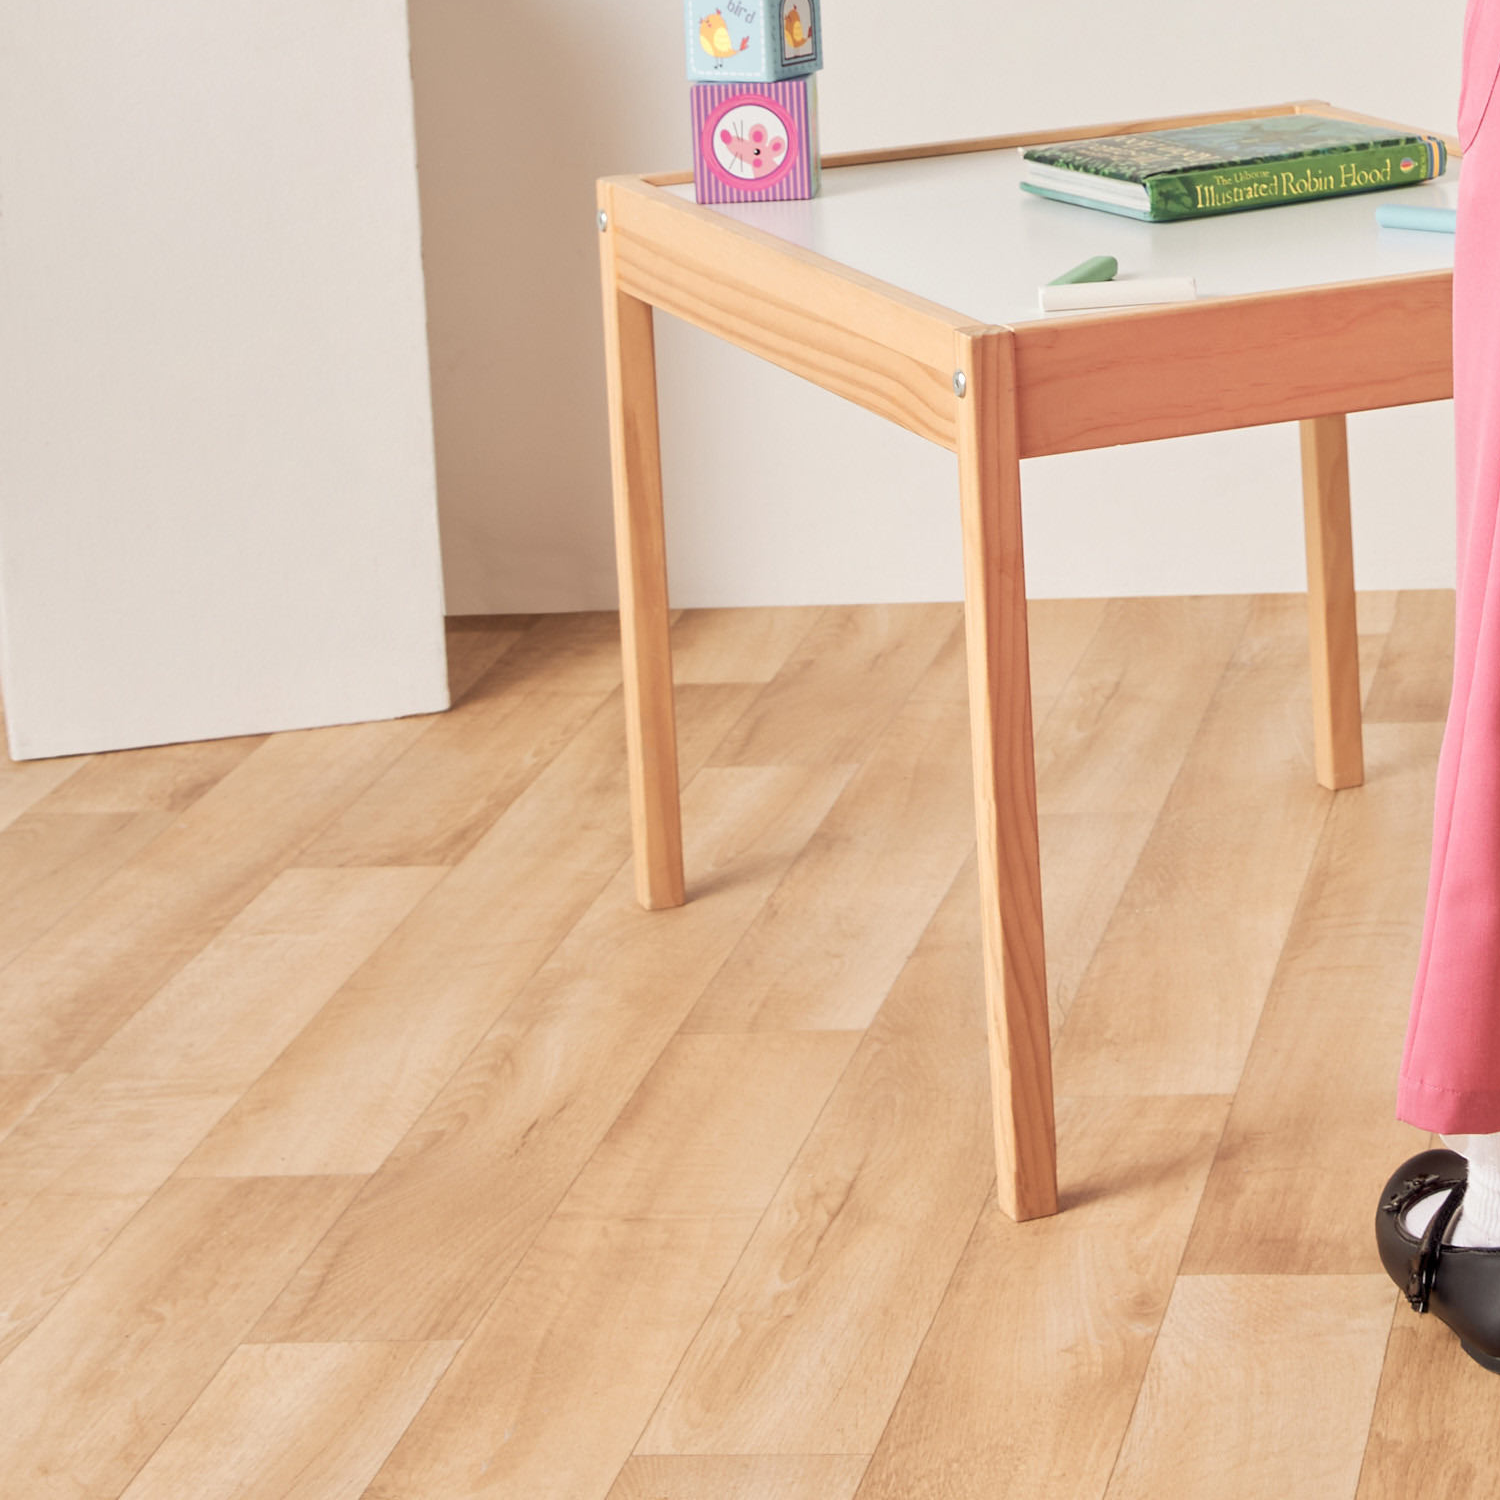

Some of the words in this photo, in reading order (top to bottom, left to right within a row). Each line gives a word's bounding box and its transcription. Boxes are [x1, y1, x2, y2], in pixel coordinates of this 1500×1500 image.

[1194, 175, 1278, 208] Illustrated
[1282, 169, 1335, 196] Robin
[1339, 158, 1391, 188] Hood
[1214, 174, 1232, 186] The
[1234, 169, 1270, 184] Usborne
